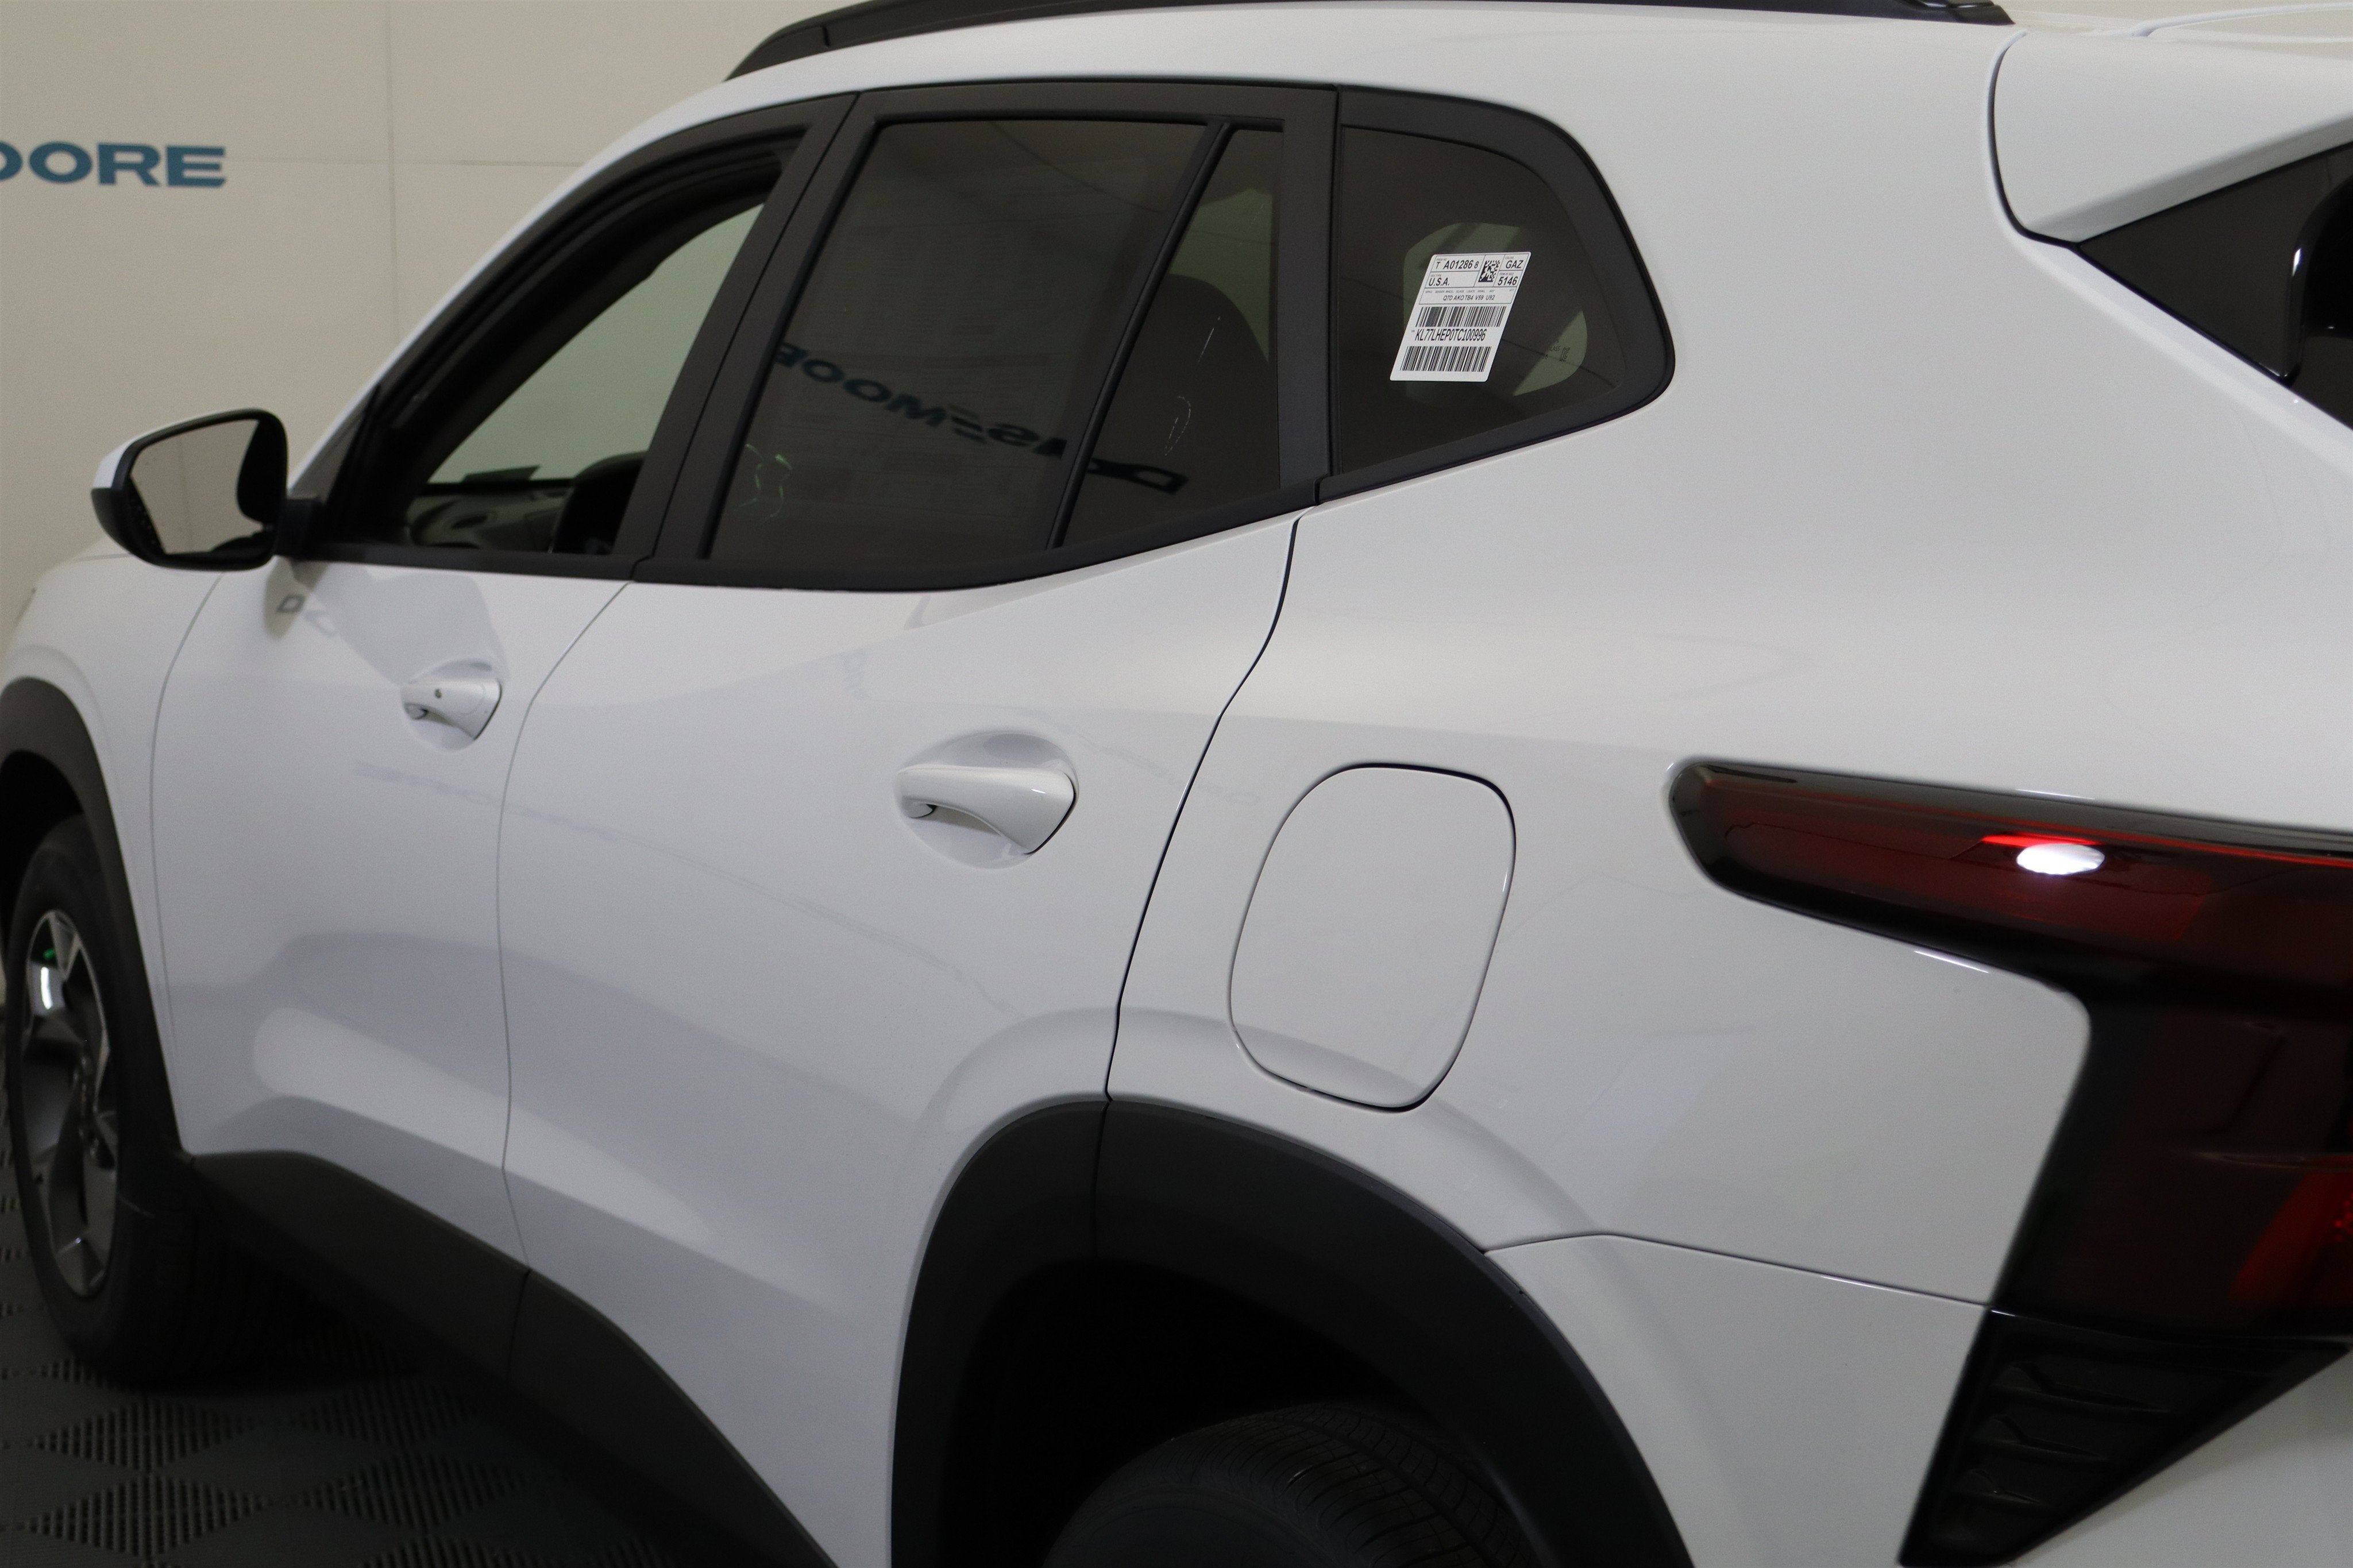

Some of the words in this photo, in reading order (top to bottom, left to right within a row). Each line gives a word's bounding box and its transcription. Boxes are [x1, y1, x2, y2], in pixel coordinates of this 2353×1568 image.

[1443, 260, 1474, 269] A01286
[1474, 261, 1479, 269] 8
[1506, 260, 1523, 269] GAZ
[1429, 277, 1450, 286] U.S.A.
[1498, 276, 1518, 285] 5146
[1415, 329, 1487, 341] KL77LHEP0TC100996
